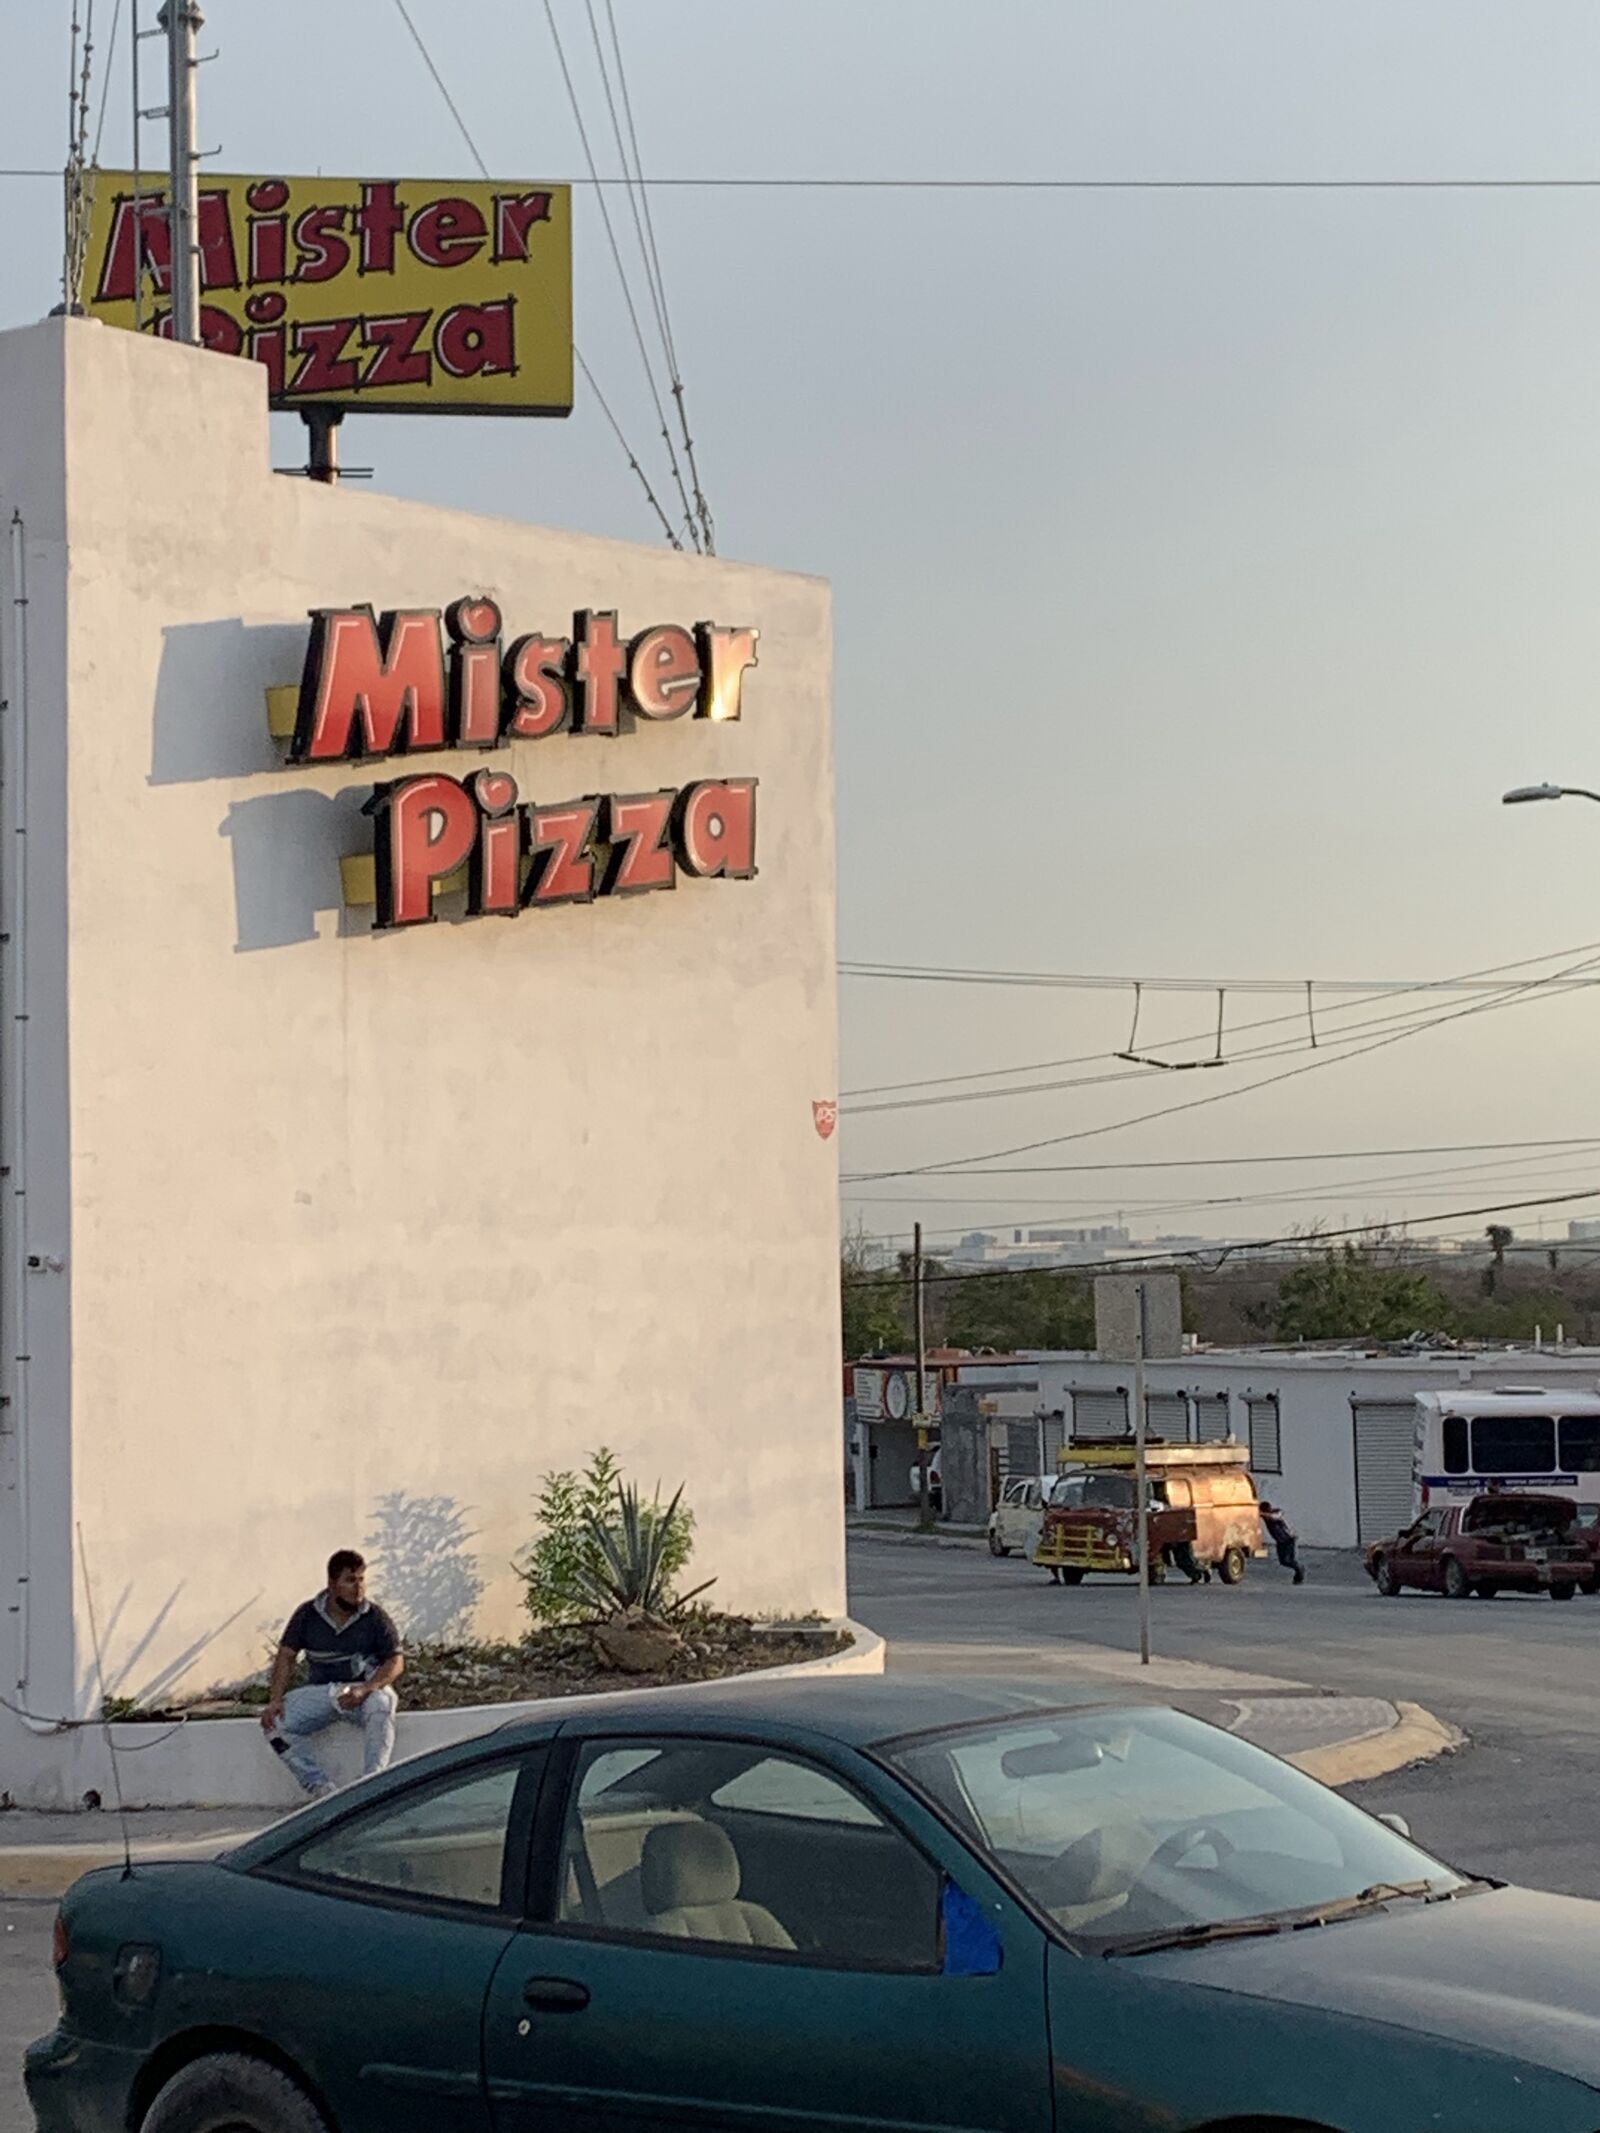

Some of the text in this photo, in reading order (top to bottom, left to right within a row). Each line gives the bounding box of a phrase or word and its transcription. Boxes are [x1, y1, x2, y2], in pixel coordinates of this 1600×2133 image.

[91, 179, 552, 303] Mister
[286, 596, 760, 765] Mister
[361, 767, 760, 929] Pizza
